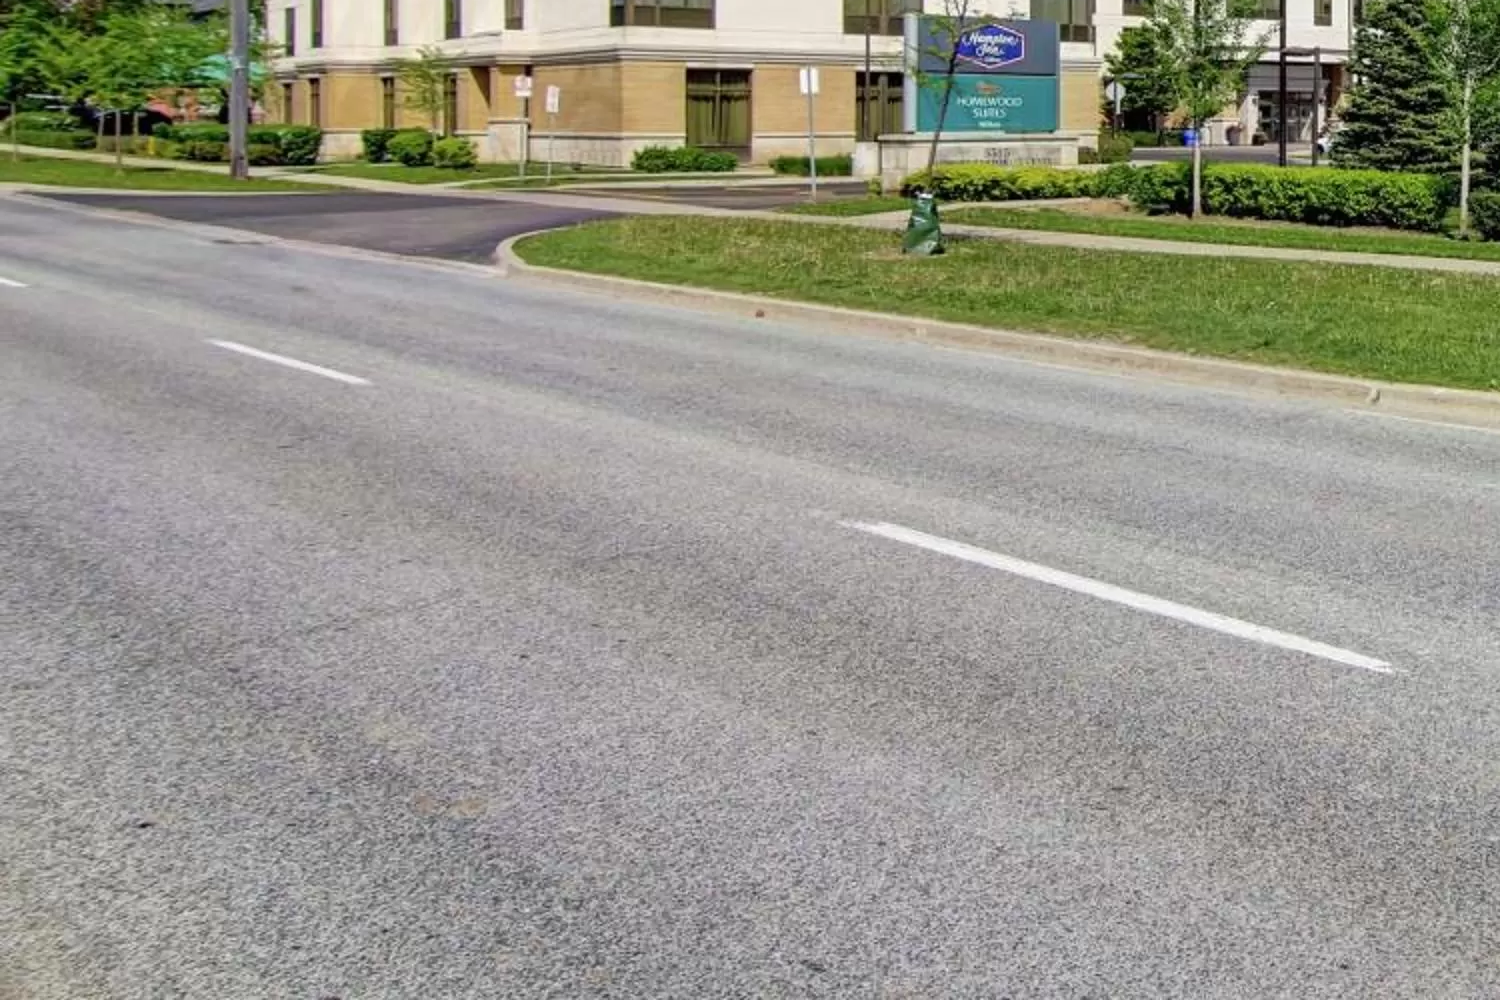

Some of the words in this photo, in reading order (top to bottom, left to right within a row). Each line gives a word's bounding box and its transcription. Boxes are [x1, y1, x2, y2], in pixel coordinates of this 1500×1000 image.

[962, 31, 1018, 47] Hampton
[957, 96, 1023, 108] HOMEWOOD
[972, 107, 1006, 119] SUITES
